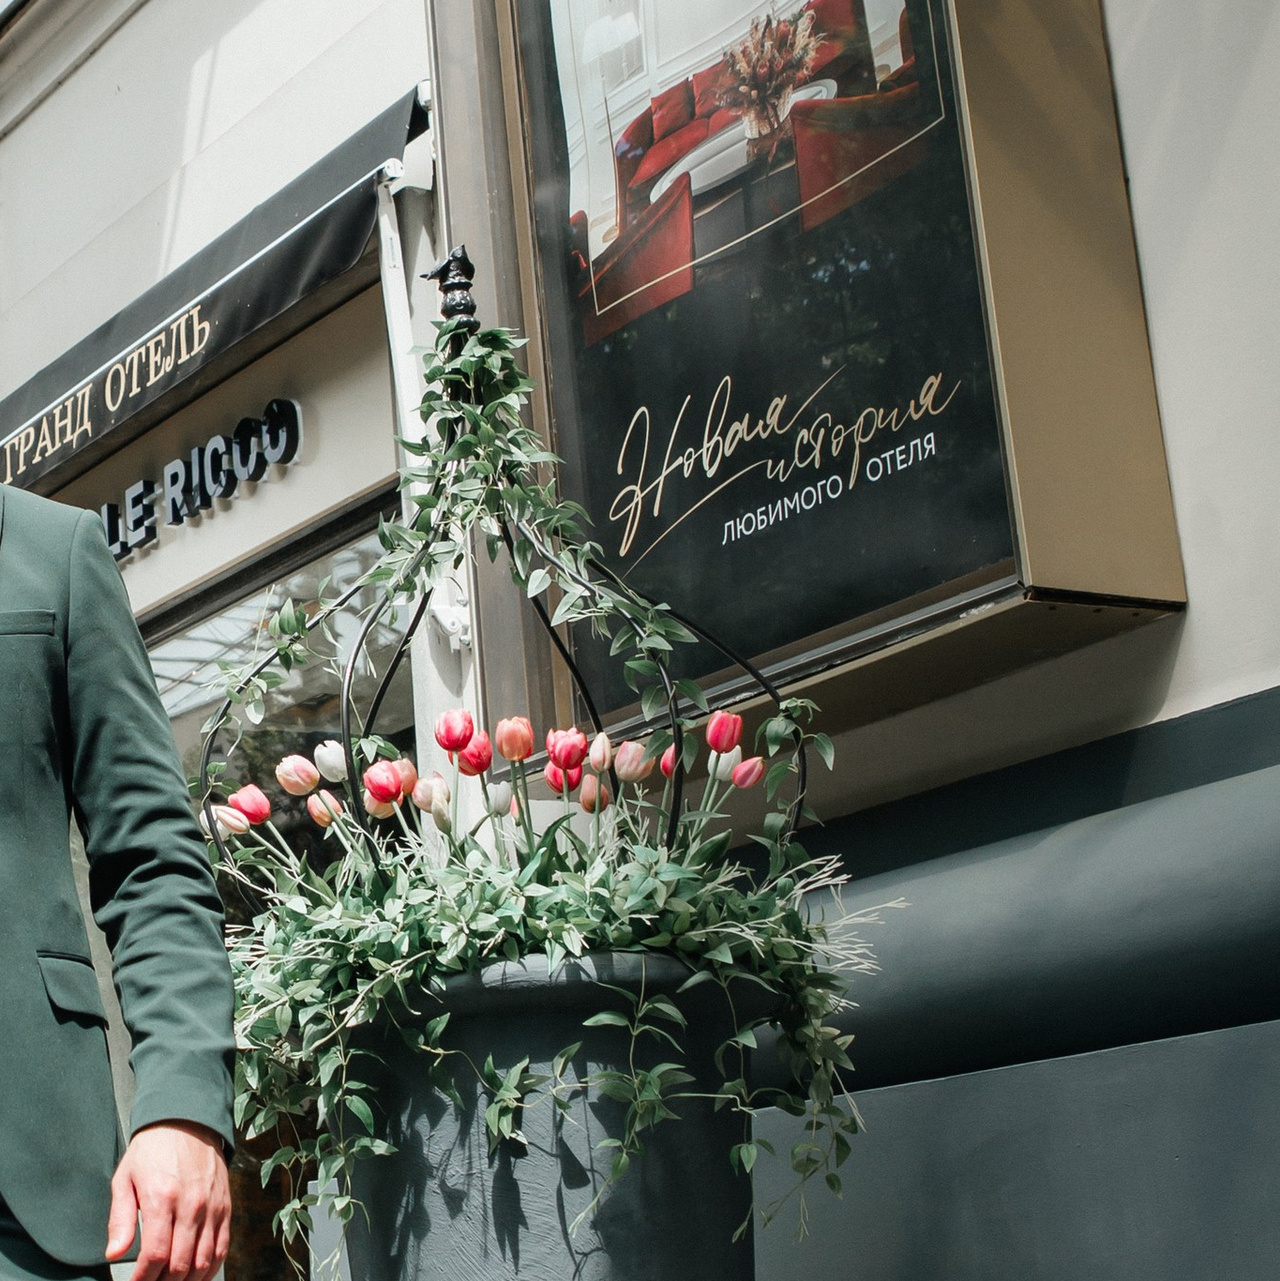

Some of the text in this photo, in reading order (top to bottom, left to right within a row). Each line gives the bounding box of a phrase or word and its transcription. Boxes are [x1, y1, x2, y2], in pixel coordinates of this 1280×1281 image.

[2, 304, 211, 485] ГРАНД ОТЕЛЬ
[163, 398, 303, 526] RICCO
[609, 364, 847, 557] Новая
[721, 431, 937, 546] ЛЮБИМОГО ОТЕЛЯ
